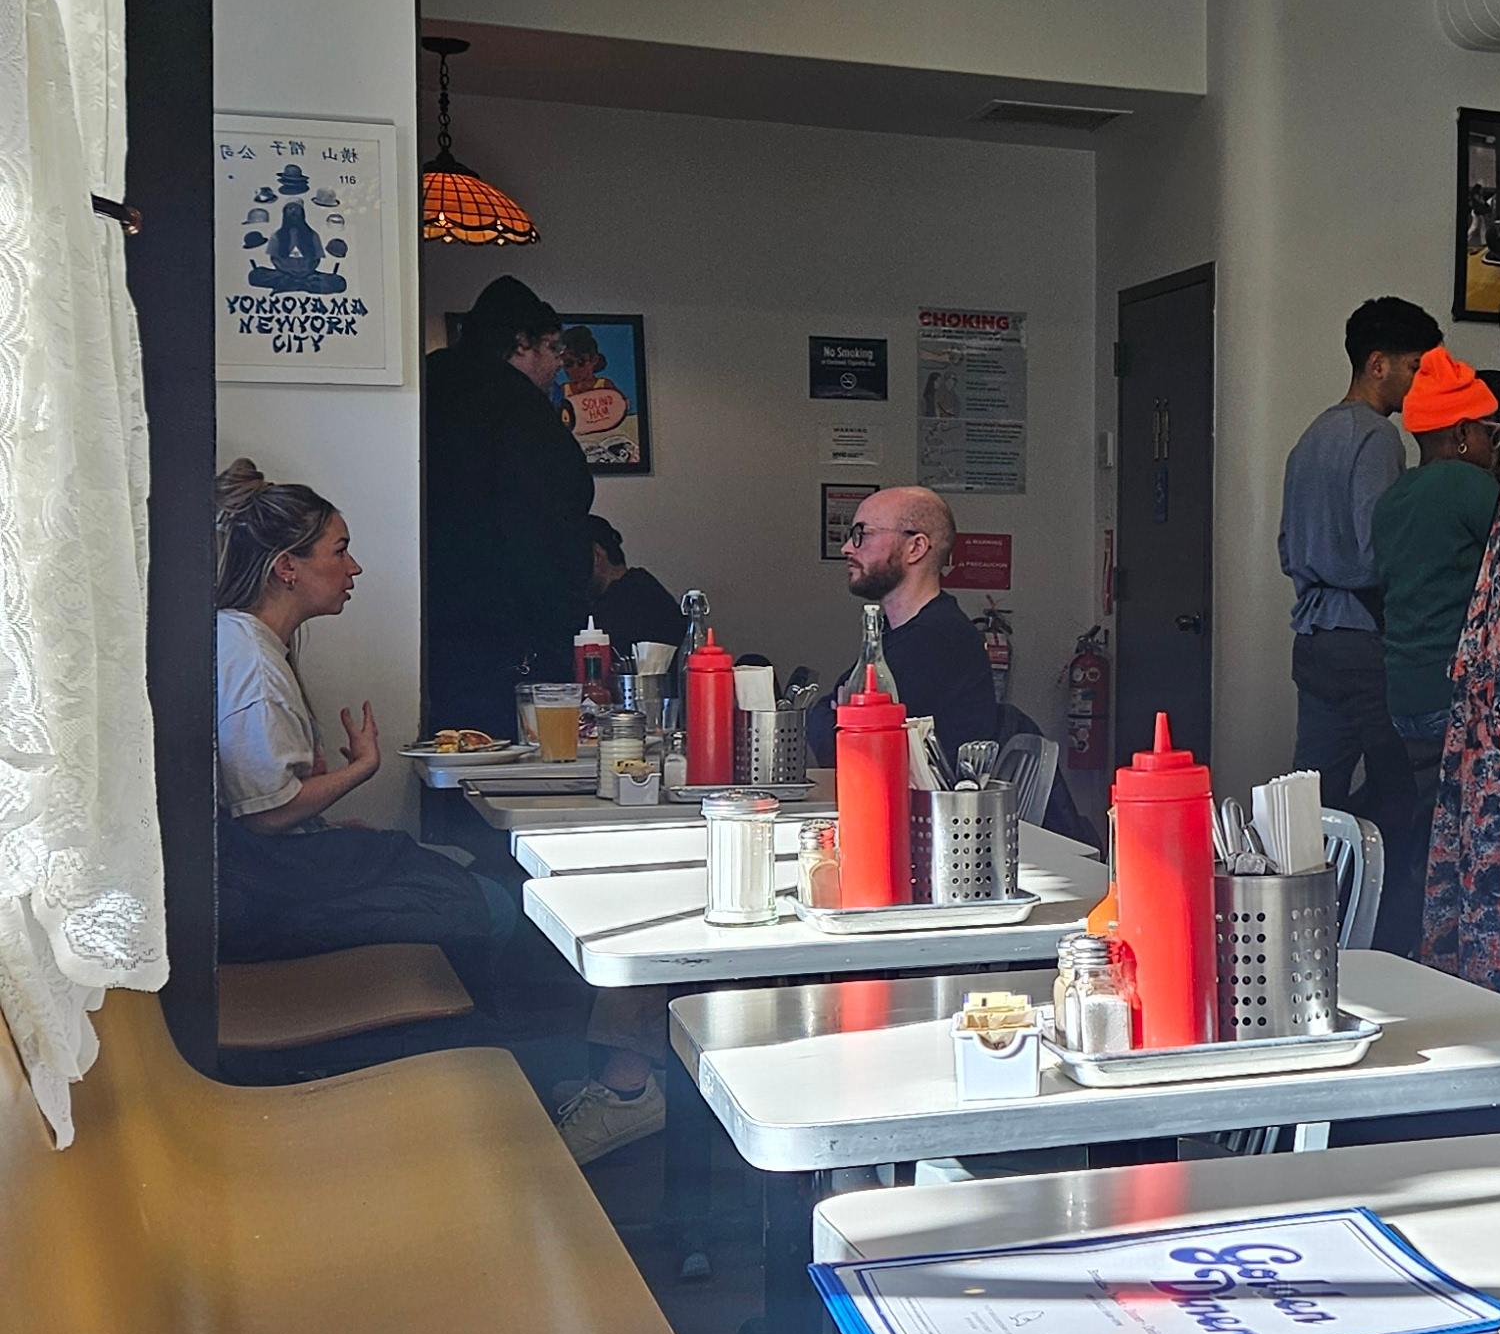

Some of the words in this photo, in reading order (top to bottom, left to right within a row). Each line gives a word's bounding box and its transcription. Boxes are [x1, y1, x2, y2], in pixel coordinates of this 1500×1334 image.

[339, 175, 356, 184] 116
[226, 295, 368, 316] YOKKOYAMA
[919, 311, 1009, 330] CHOKING
[272, 334, 325, 353] CITY
[824, 347, 835, 357] No
[837, 347, 873, 360] Smoking
[1169, 1244, 1349, 1324] Golden
